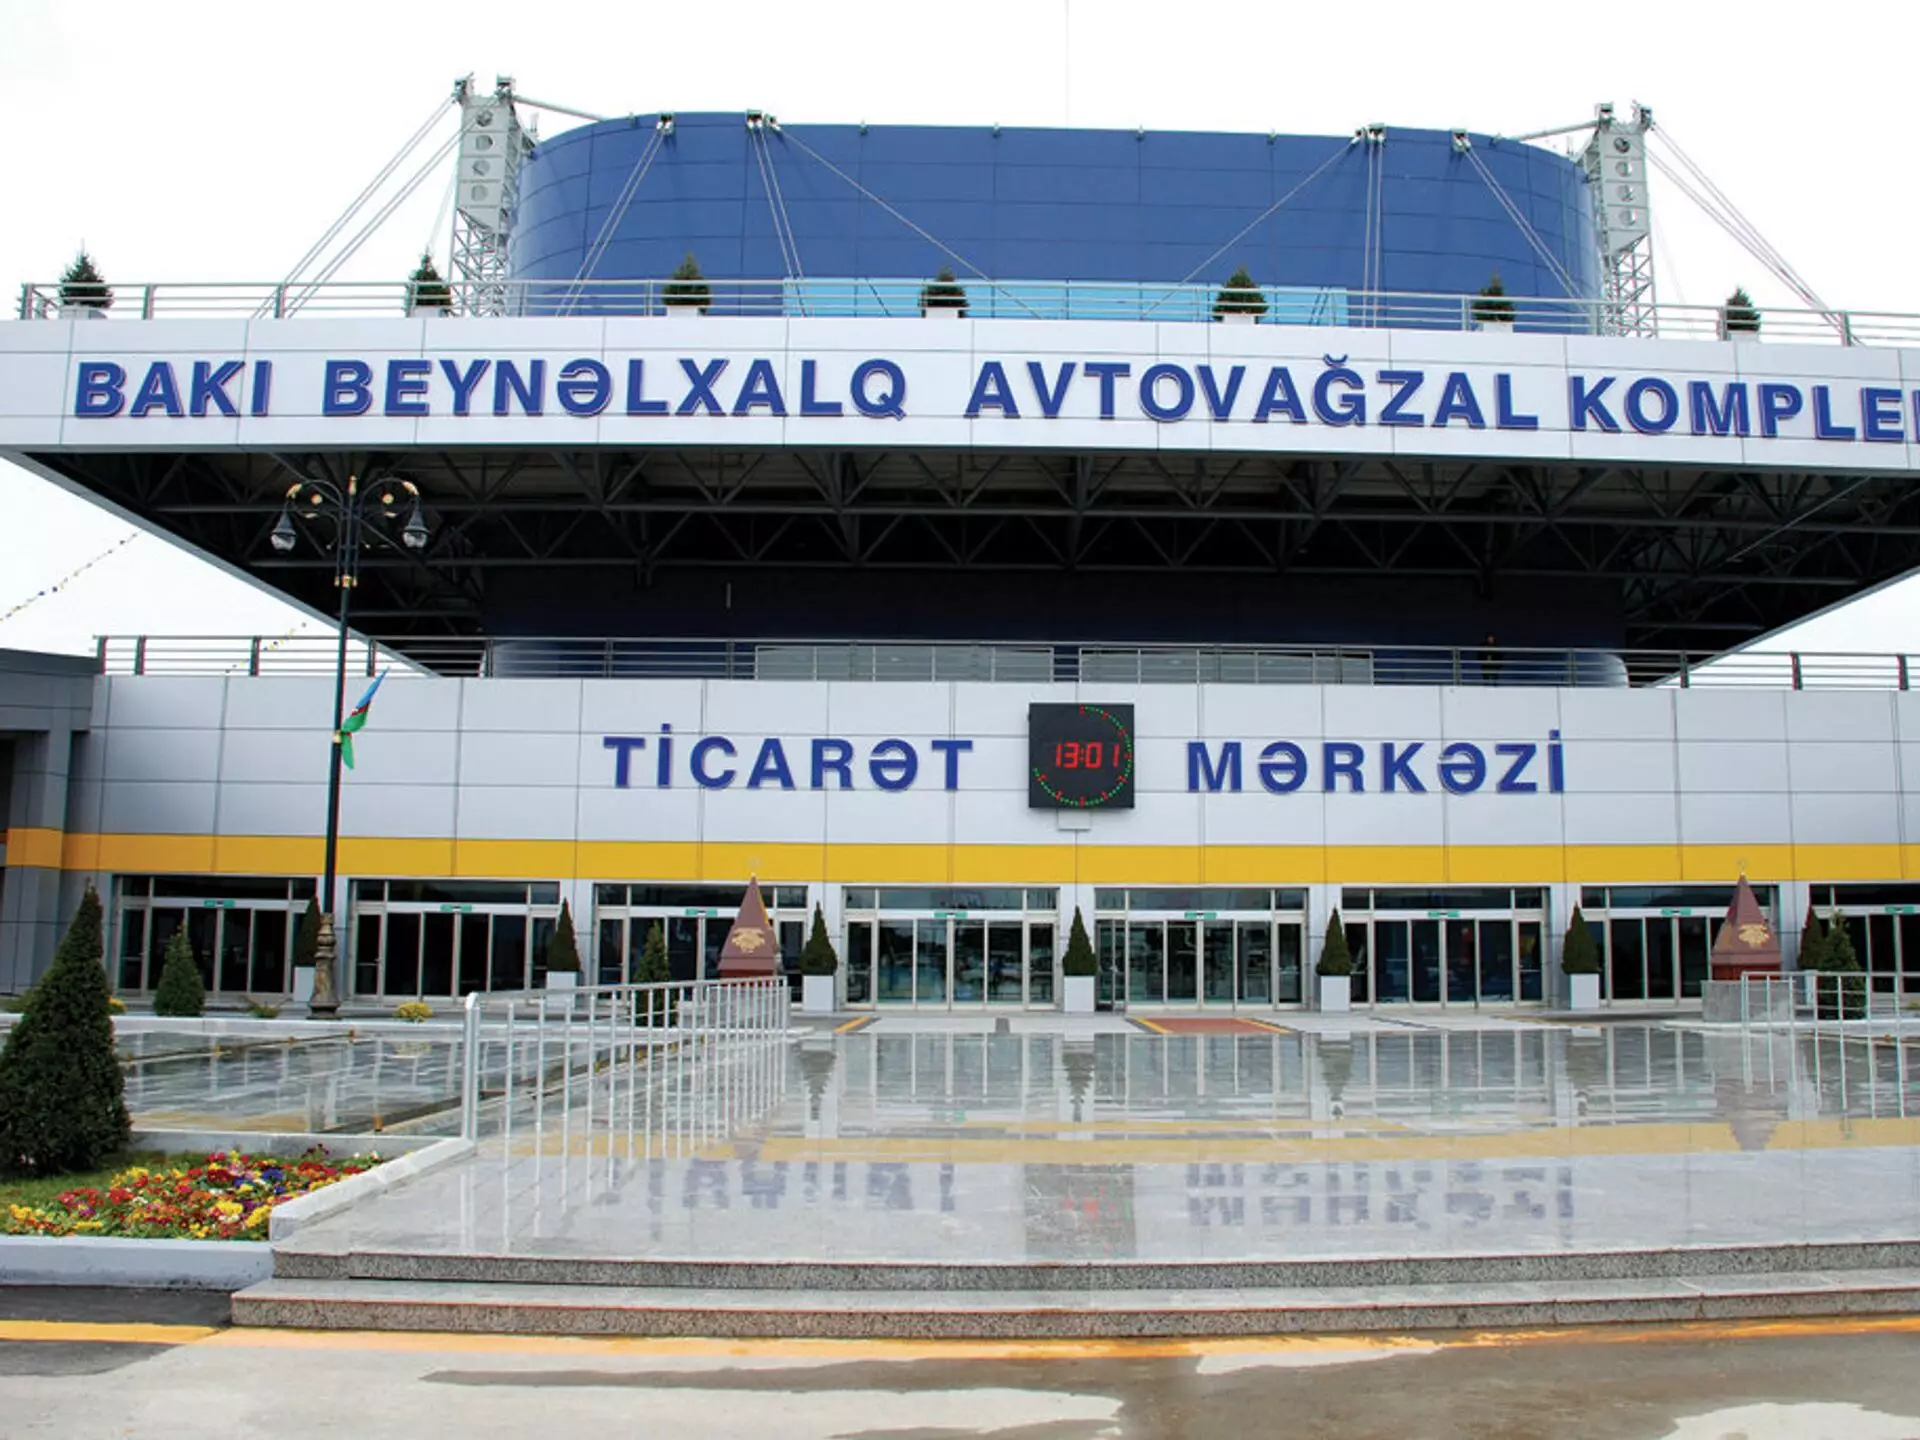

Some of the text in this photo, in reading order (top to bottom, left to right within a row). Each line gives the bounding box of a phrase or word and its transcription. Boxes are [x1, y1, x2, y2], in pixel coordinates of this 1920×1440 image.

[73, 353, 1920, 445] BAKI BEYNƏLXALQ AVTOVAĞZAL KOMPLE
[602, 722, 975, 793] TİCARƏT
[1186, 729, 1566, 796] MƏRKƏZİ
